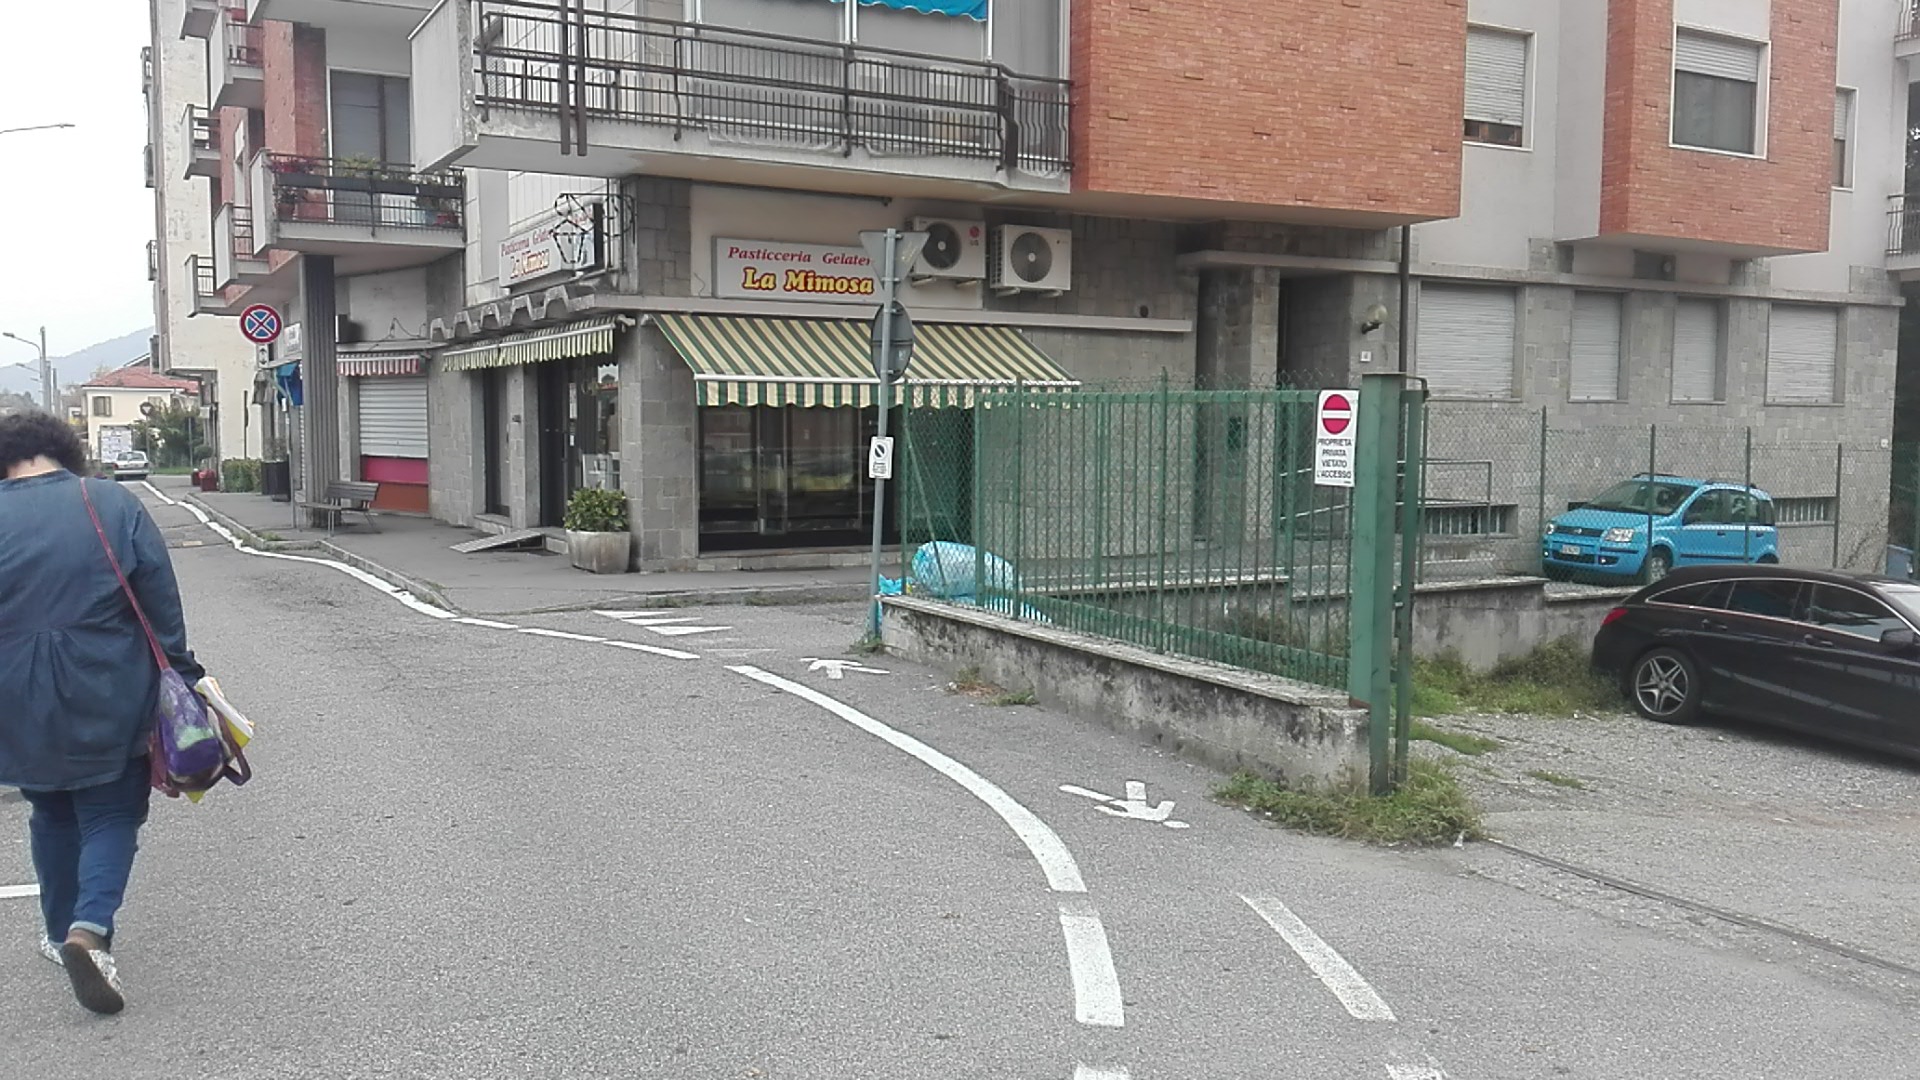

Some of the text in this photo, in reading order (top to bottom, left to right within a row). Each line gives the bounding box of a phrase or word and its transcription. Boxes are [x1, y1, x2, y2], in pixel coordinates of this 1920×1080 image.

[727, 246, 871, 267] Pasticceria Gelater
[742, 266, 874, 295] La Mimosa
[1321, 459, 1347, 468] VIETATO
[1316, 470, 1351, 479] L'ACCESSO
